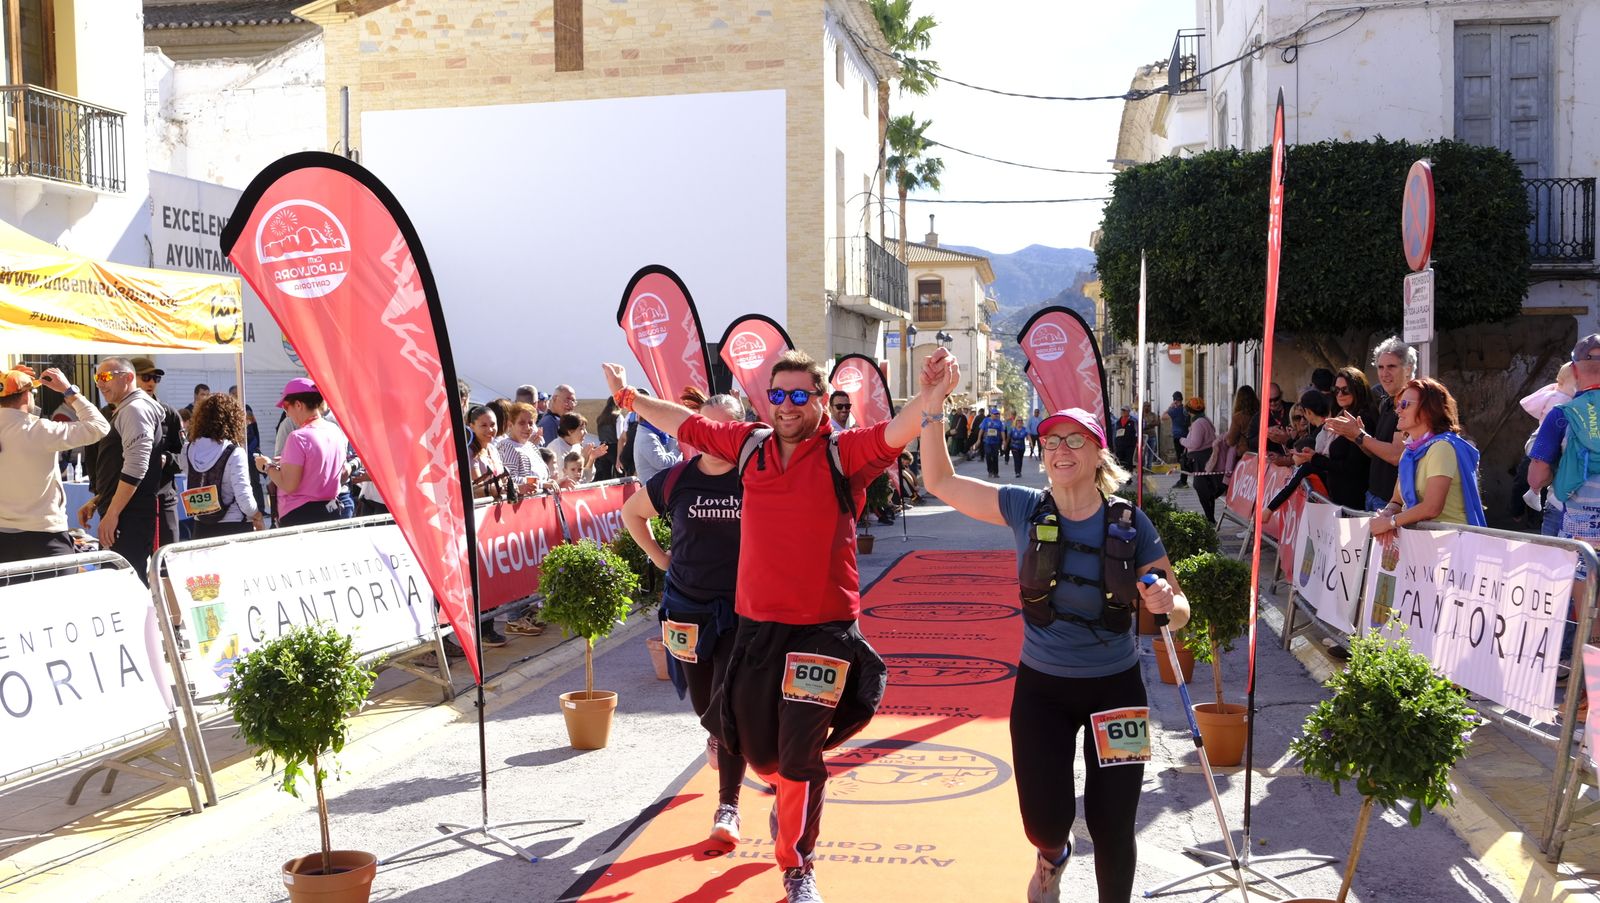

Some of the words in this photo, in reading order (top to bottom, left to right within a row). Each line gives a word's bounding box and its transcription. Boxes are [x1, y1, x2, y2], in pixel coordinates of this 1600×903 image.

[163, 206, 230, 237] EXCELEN
[189, 493, 212, 505] 439
[696, 495, 742, 510] Lovely
[478, 527, 549, 578] VEOLIA
[243, 557, 383, 597] AYUNTAMIENTO
[389, 553, 410, 570] DE
[247, 574, 422, 643] CANTORIA
[1531, 589, 1552, 615] DE
[92, 611, 124, 637] DE
[1396, 589, 1549, 673] CANTORIA
[795, 665, 836, 684] 600
[1107, 720, 1147, 740] 601
[739, 837, 882, 851] Canria
[894, 842, 937, 854] de
[704, 850, 956, 868] Ayuntaento
